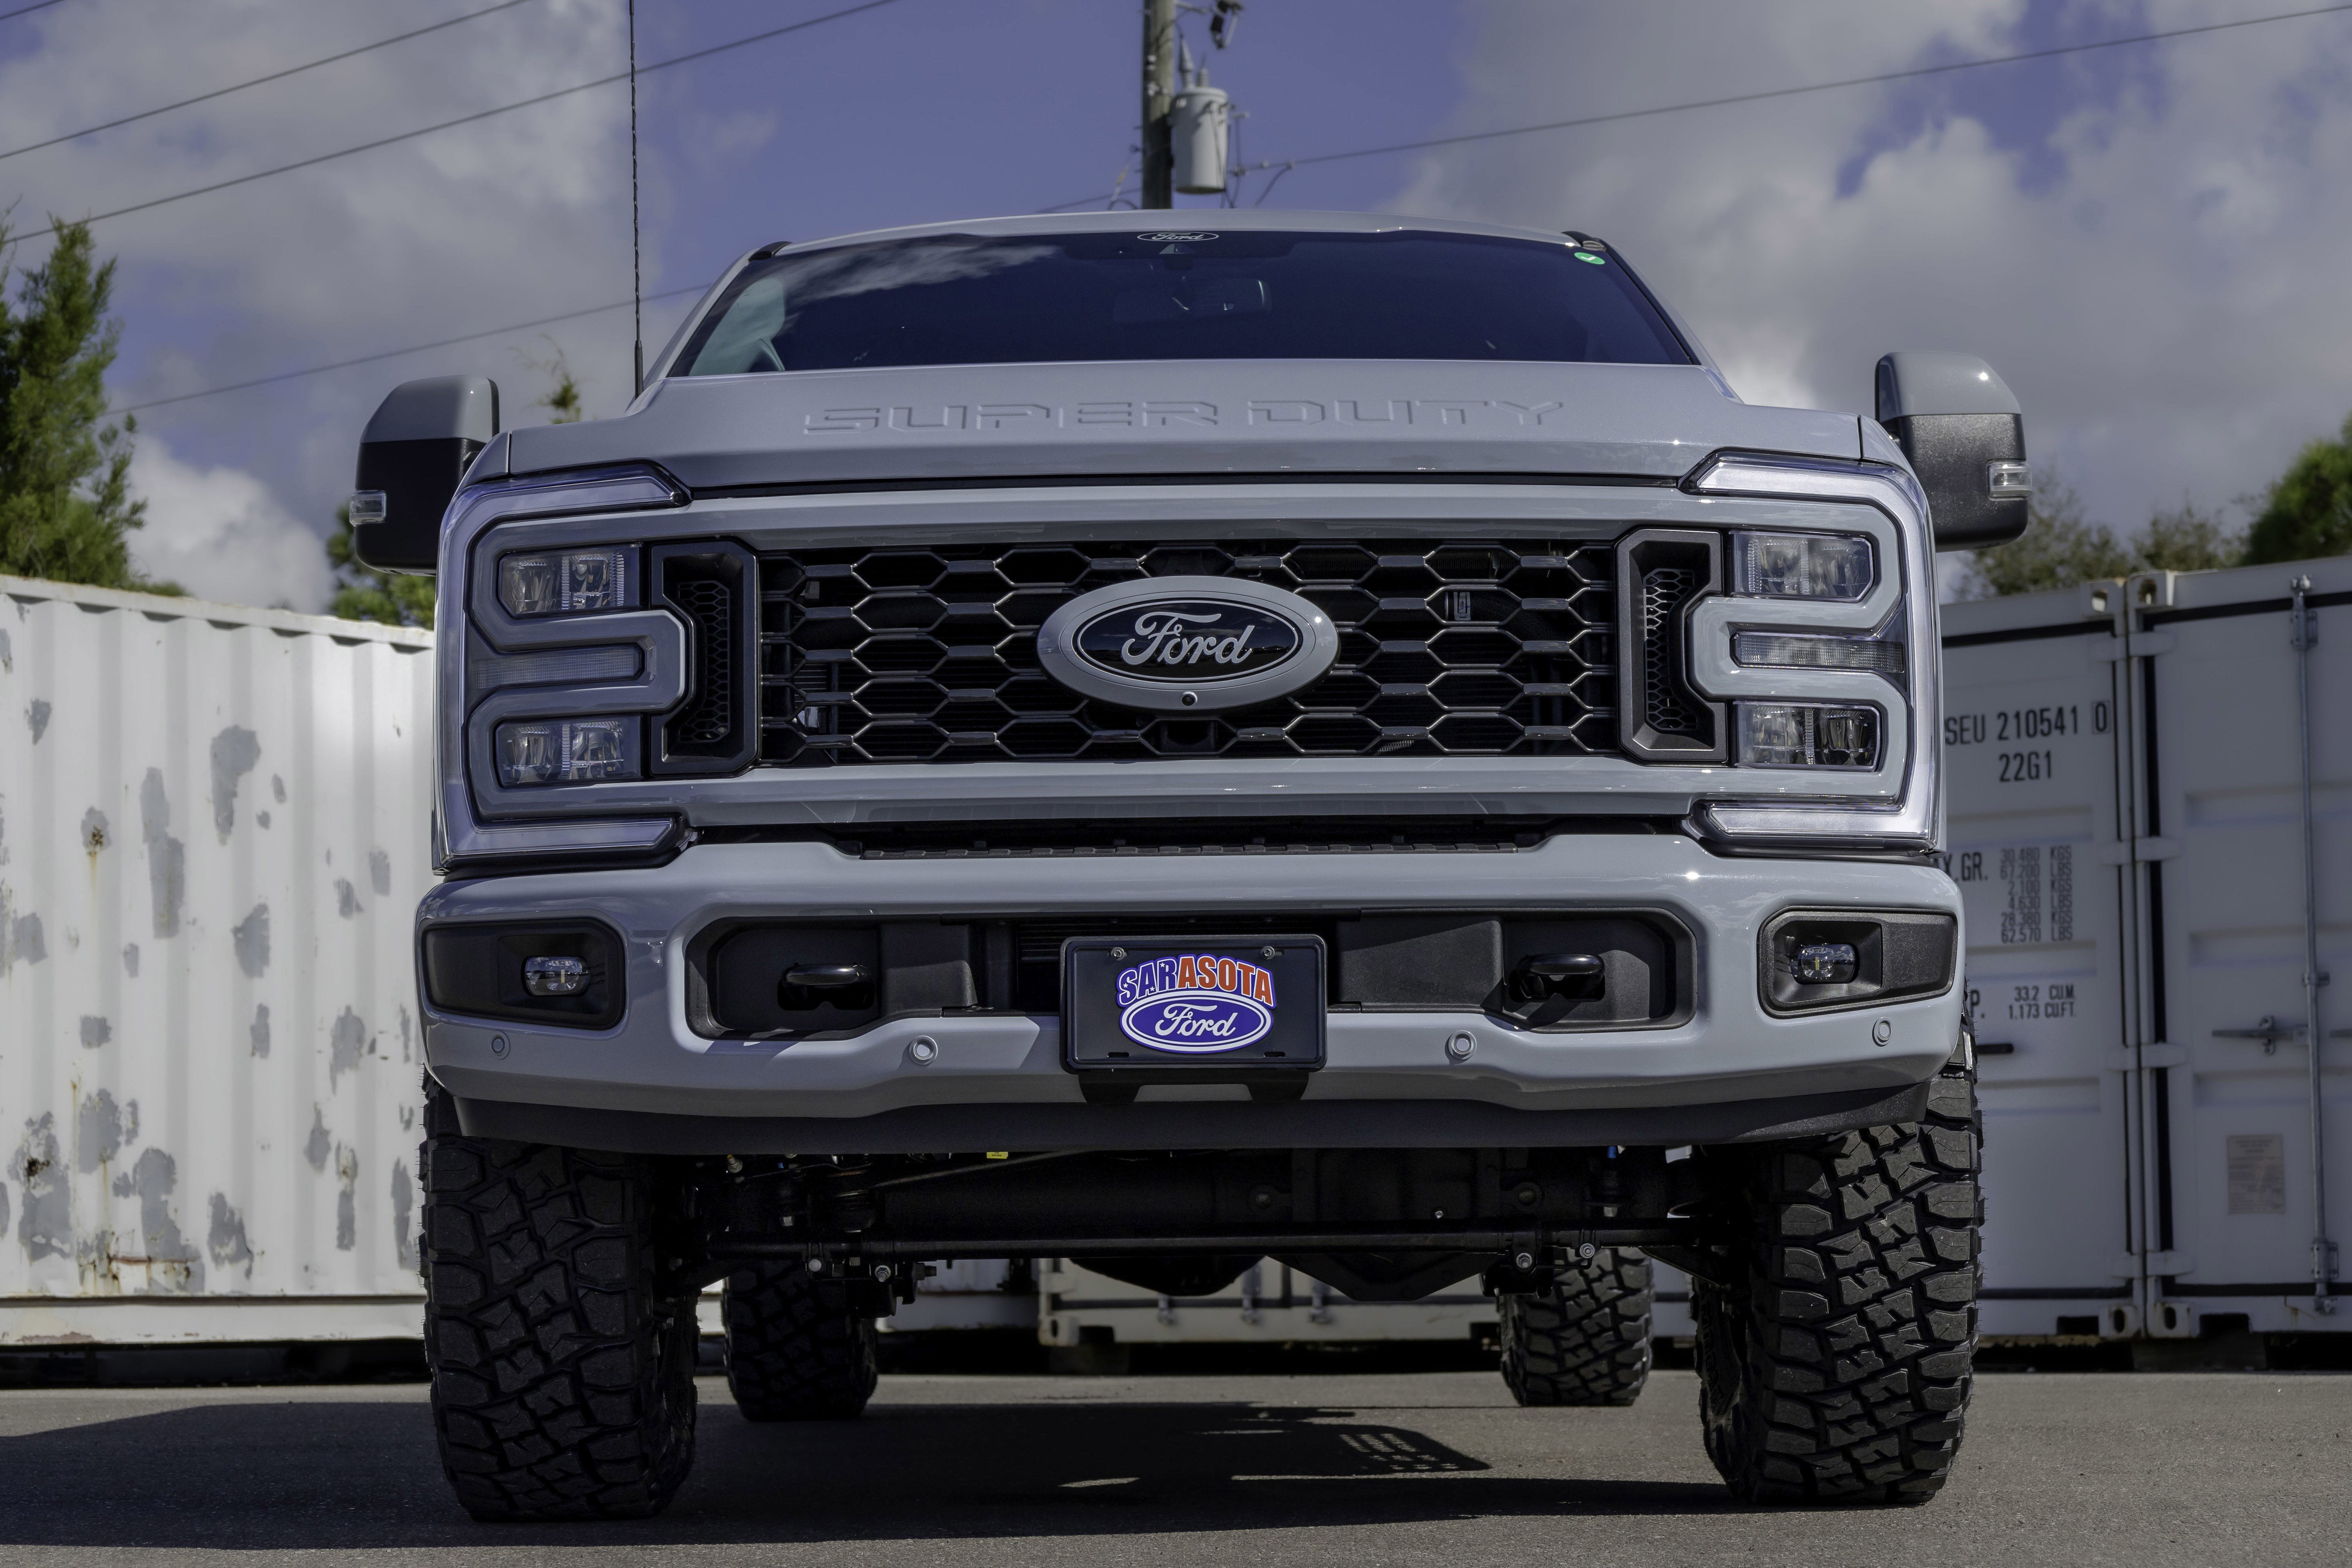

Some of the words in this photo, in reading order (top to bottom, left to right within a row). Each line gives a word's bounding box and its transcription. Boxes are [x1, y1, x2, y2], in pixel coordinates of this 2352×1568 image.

[804, 401, 1218, 434] SUPER
[1247, 400, 1564, 425] DUTY
[1121, 611, 1255, 665] Ford
[1944, 714, 1986, 746] SEU
[1997, 706, 2078, 741] 210541
[1999, 750, 2052, 782] 22G1
[2050, 845, 2071, 862] KGS
[2050, 862, 2072, 878] LBS
[2050, 878, 2072, 894] KGS
[2051, 894, 2073, 911] LBS
[2051, 909, 2073, 927] KGS
[2051, 926, 2073, 942] LBS
[1118, 955, 1274, 1008] SARASOTA
[1155, 1003, 1238, 1036] Ford
[2009, 1003, 2040, 1020] 1.173
